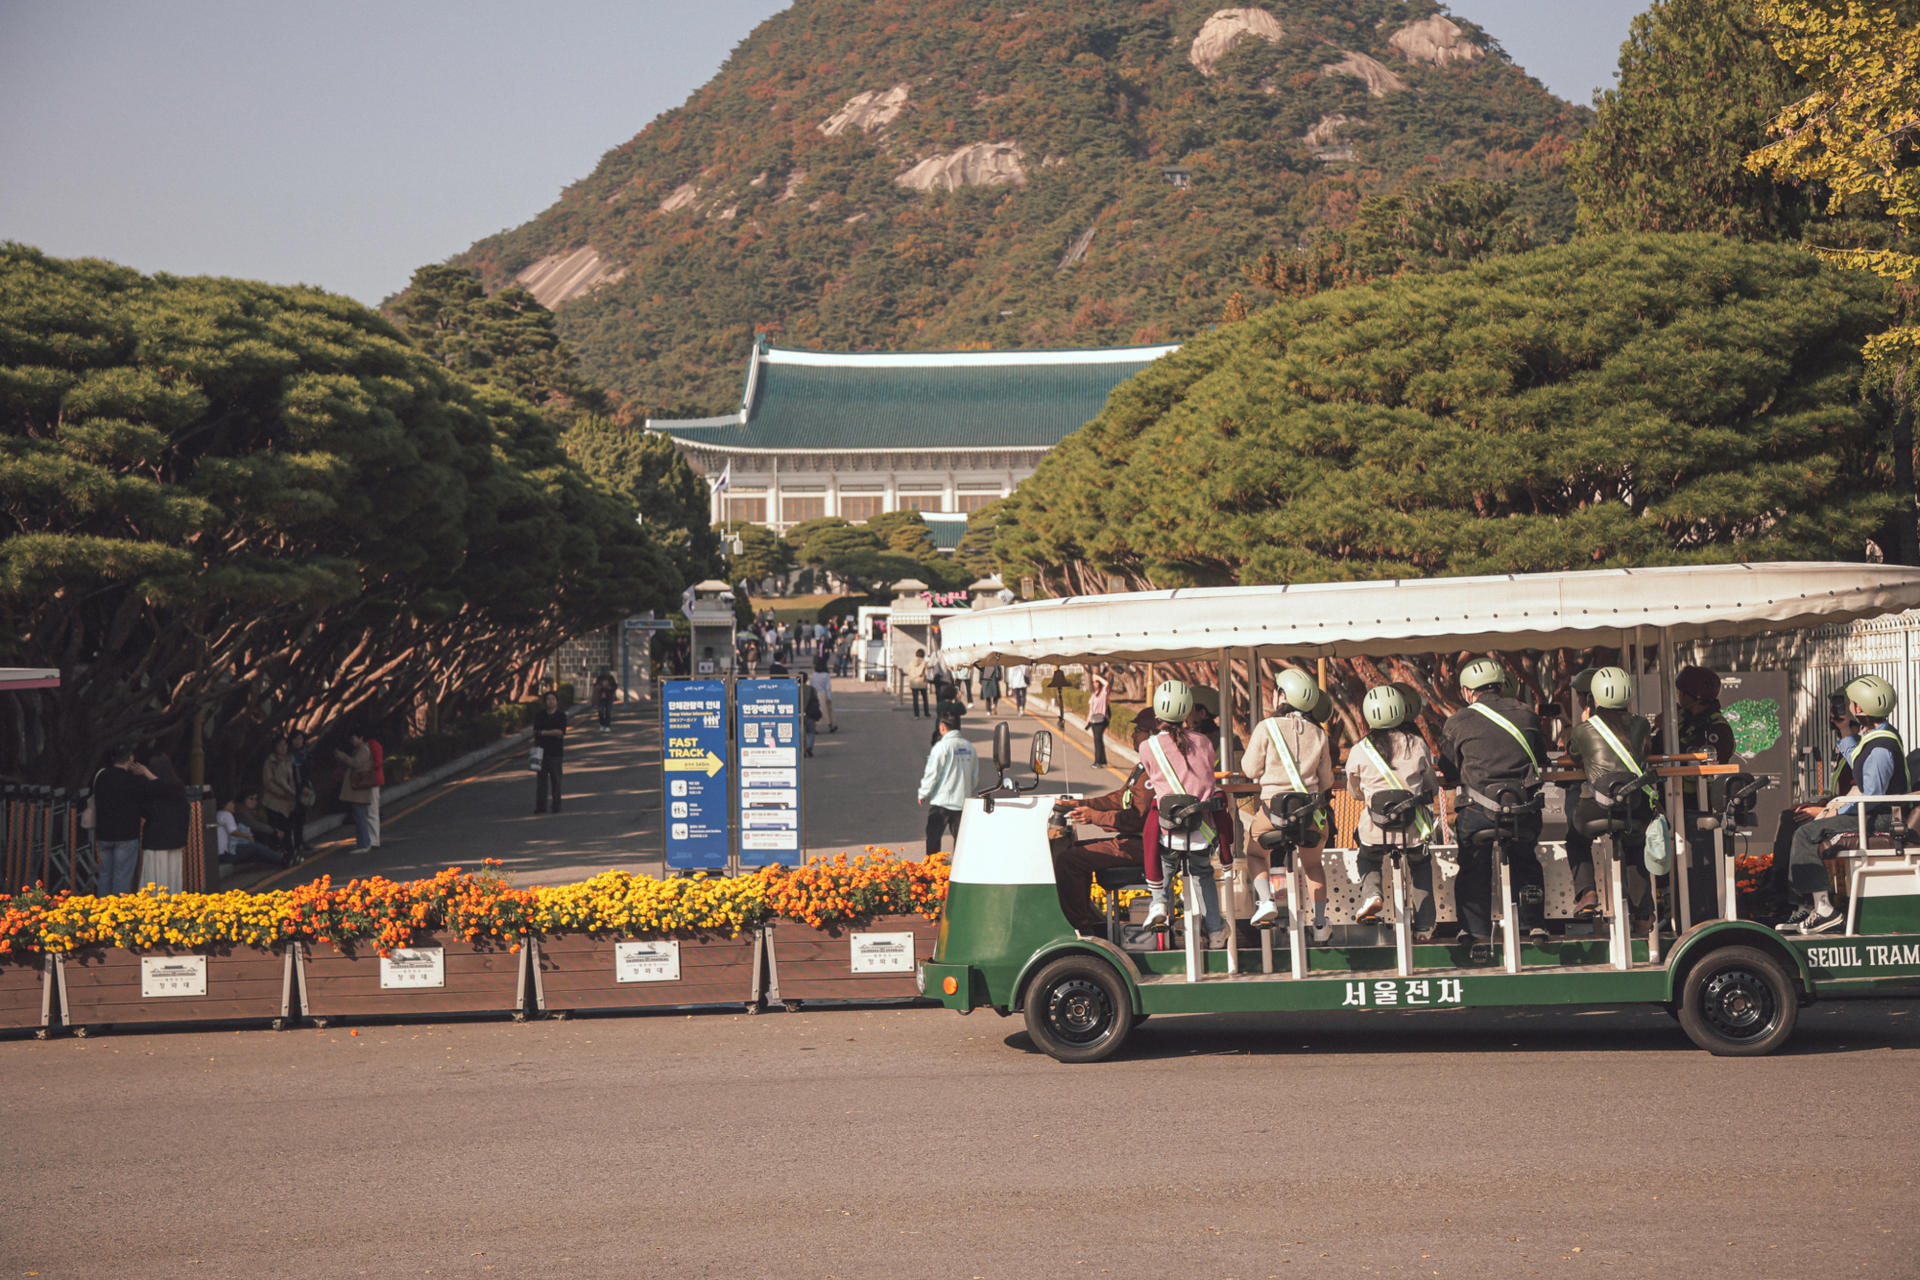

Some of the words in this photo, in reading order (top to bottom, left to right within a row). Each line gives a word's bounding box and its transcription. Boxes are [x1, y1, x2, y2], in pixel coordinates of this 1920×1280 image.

[705, 700, 720, 710] 안내
[742, 704, 775, 714] 현장예약
[777, 704, 794, 714] 방법
[669, 738, 698, 747] FAST
[669, 749, 704, 757] TRACK
[1807, 946, 1862, 967] SEOUL
[1866, 944, 1920, 966] TRAM
[1342, 979, 1464, 1006] 서울전차
